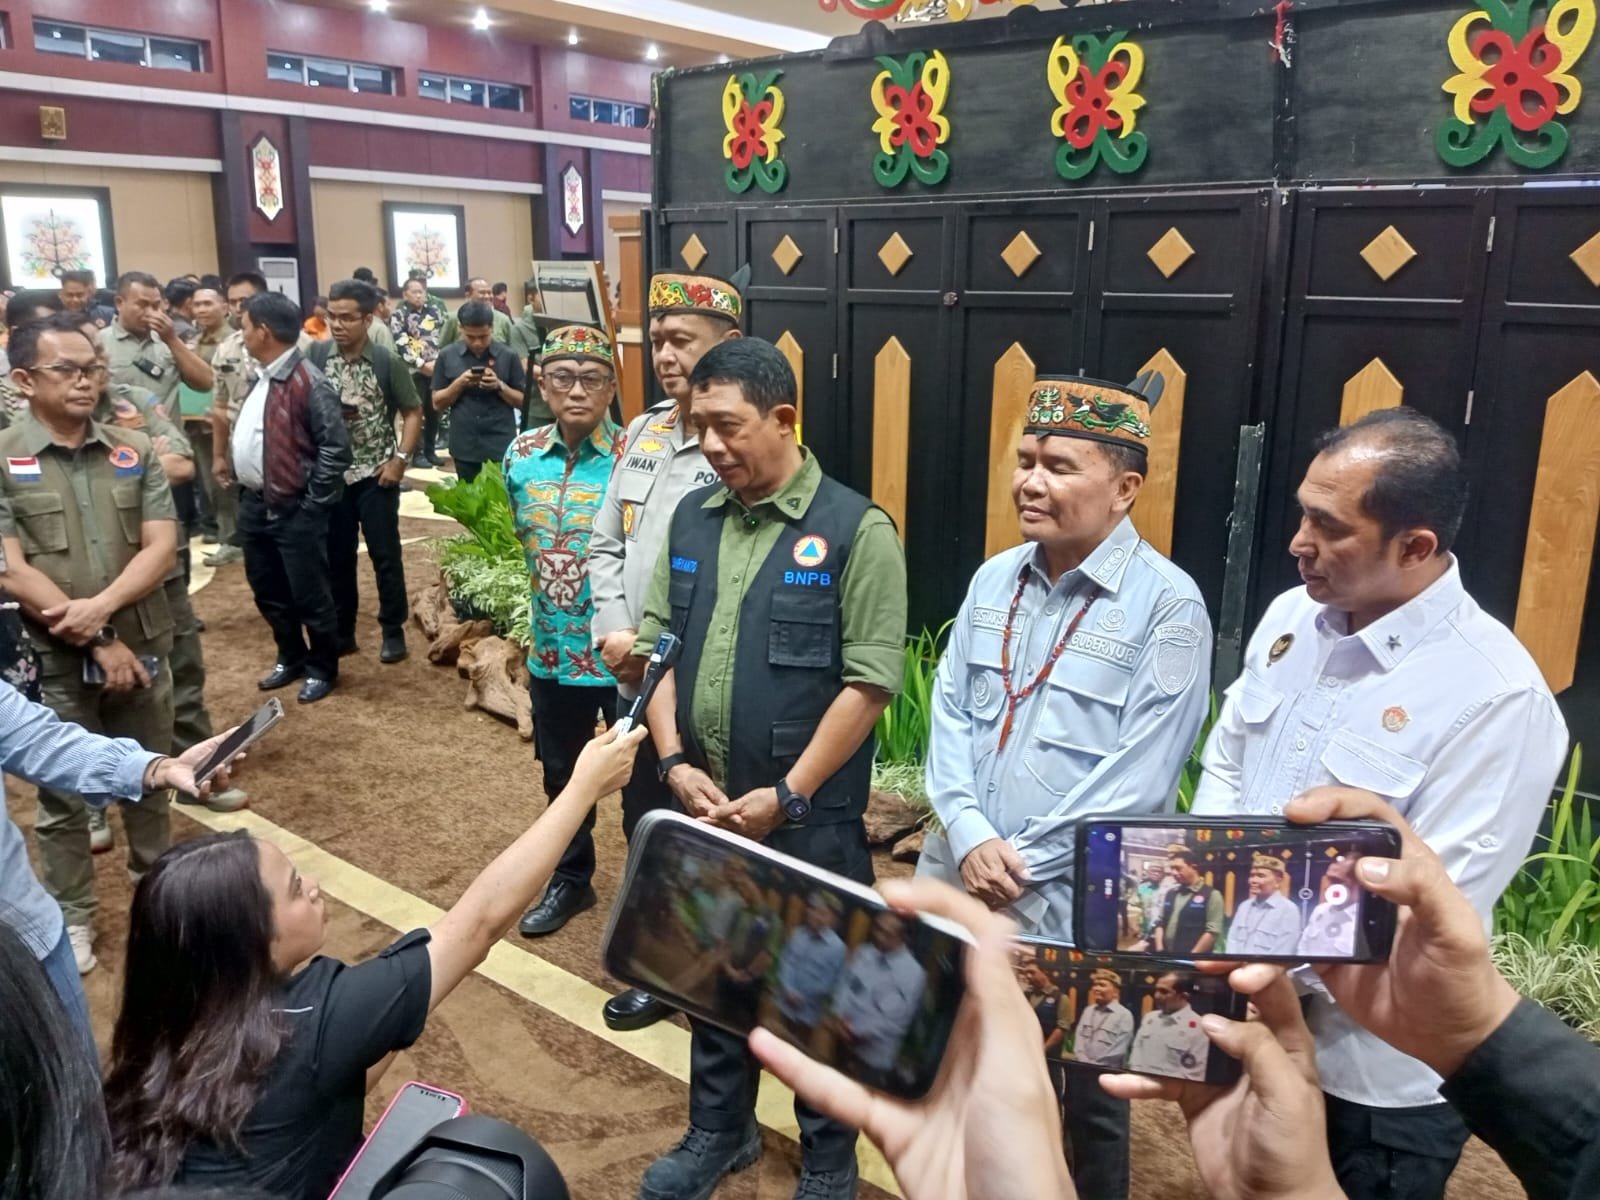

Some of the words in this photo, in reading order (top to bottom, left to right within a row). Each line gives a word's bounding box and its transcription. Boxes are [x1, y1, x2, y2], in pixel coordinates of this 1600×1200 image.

[625, 455, 658, 472] IWAN
[784, 571, 831, 586] BNPB
[1070, 632, 1136, 663] GUBERNUR
